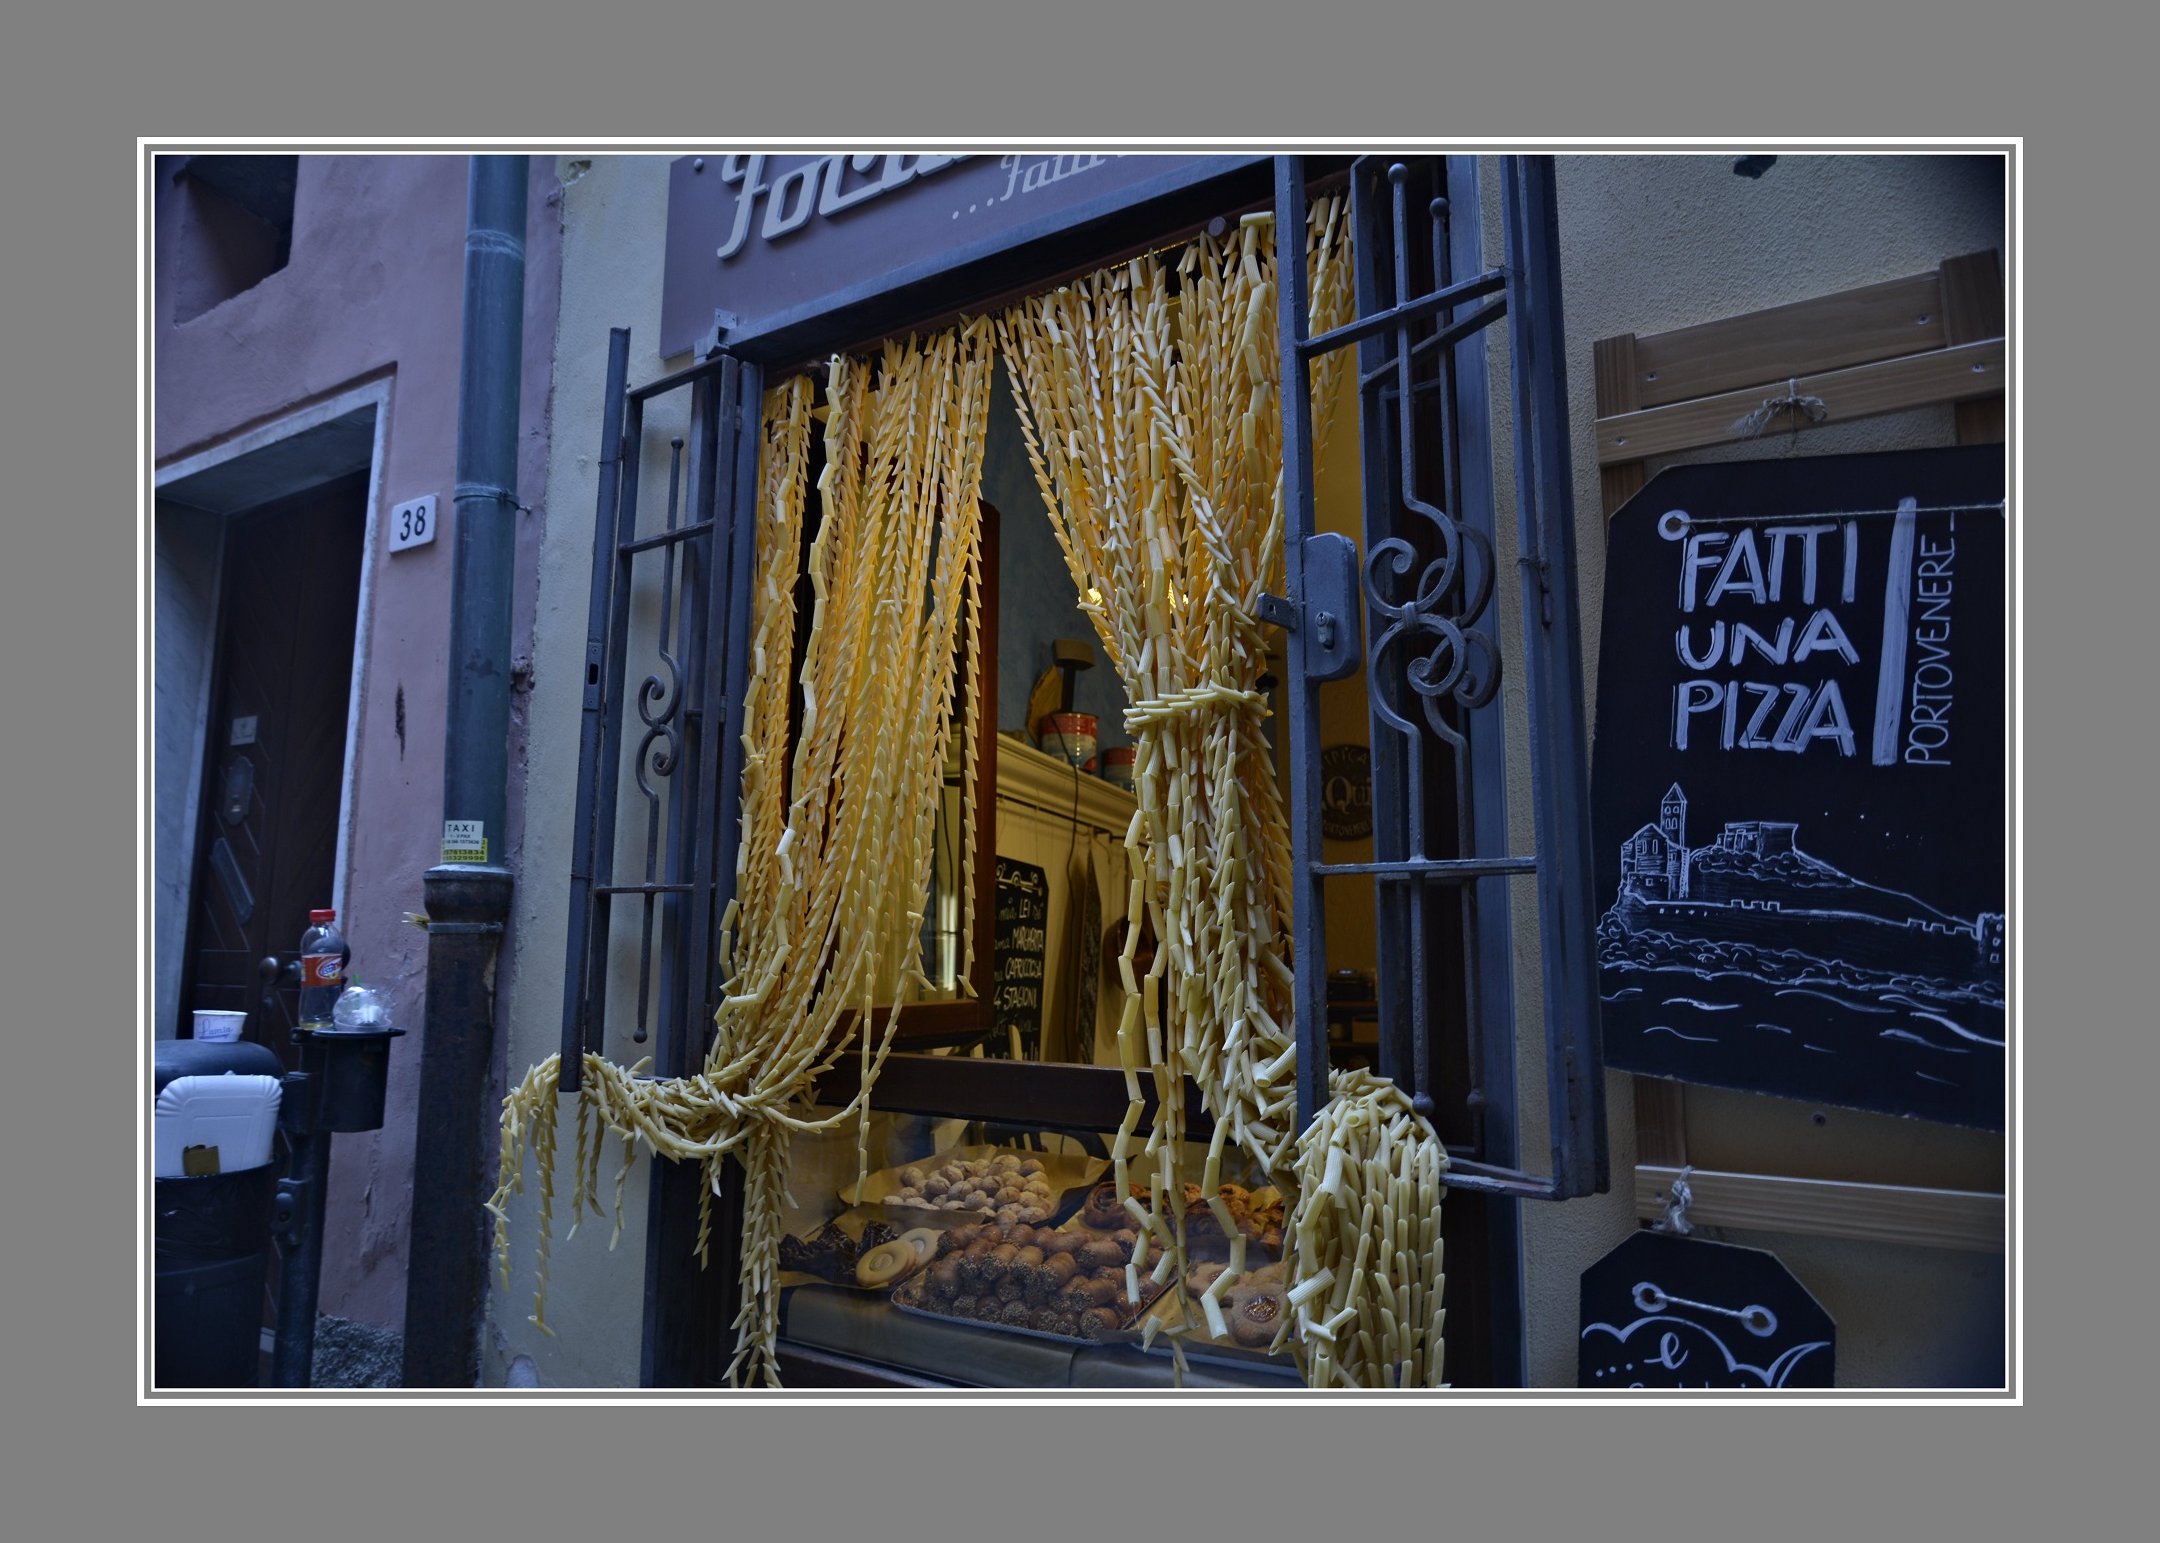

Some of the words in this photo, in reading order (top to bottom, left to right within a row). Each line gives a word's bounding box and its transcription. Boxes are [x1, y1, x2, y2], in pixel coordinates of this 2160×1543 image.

[400, 505, 426, 541] 38
[1679, 520, 1858, 613] FATTI
[1675, 608, 1860, 671] UNA
[1904, 534, 1957, 765] PORTOVENERE
[1670, 679, 1857, 757] PIZZA
[447, 824, 475, 832] TAXI
